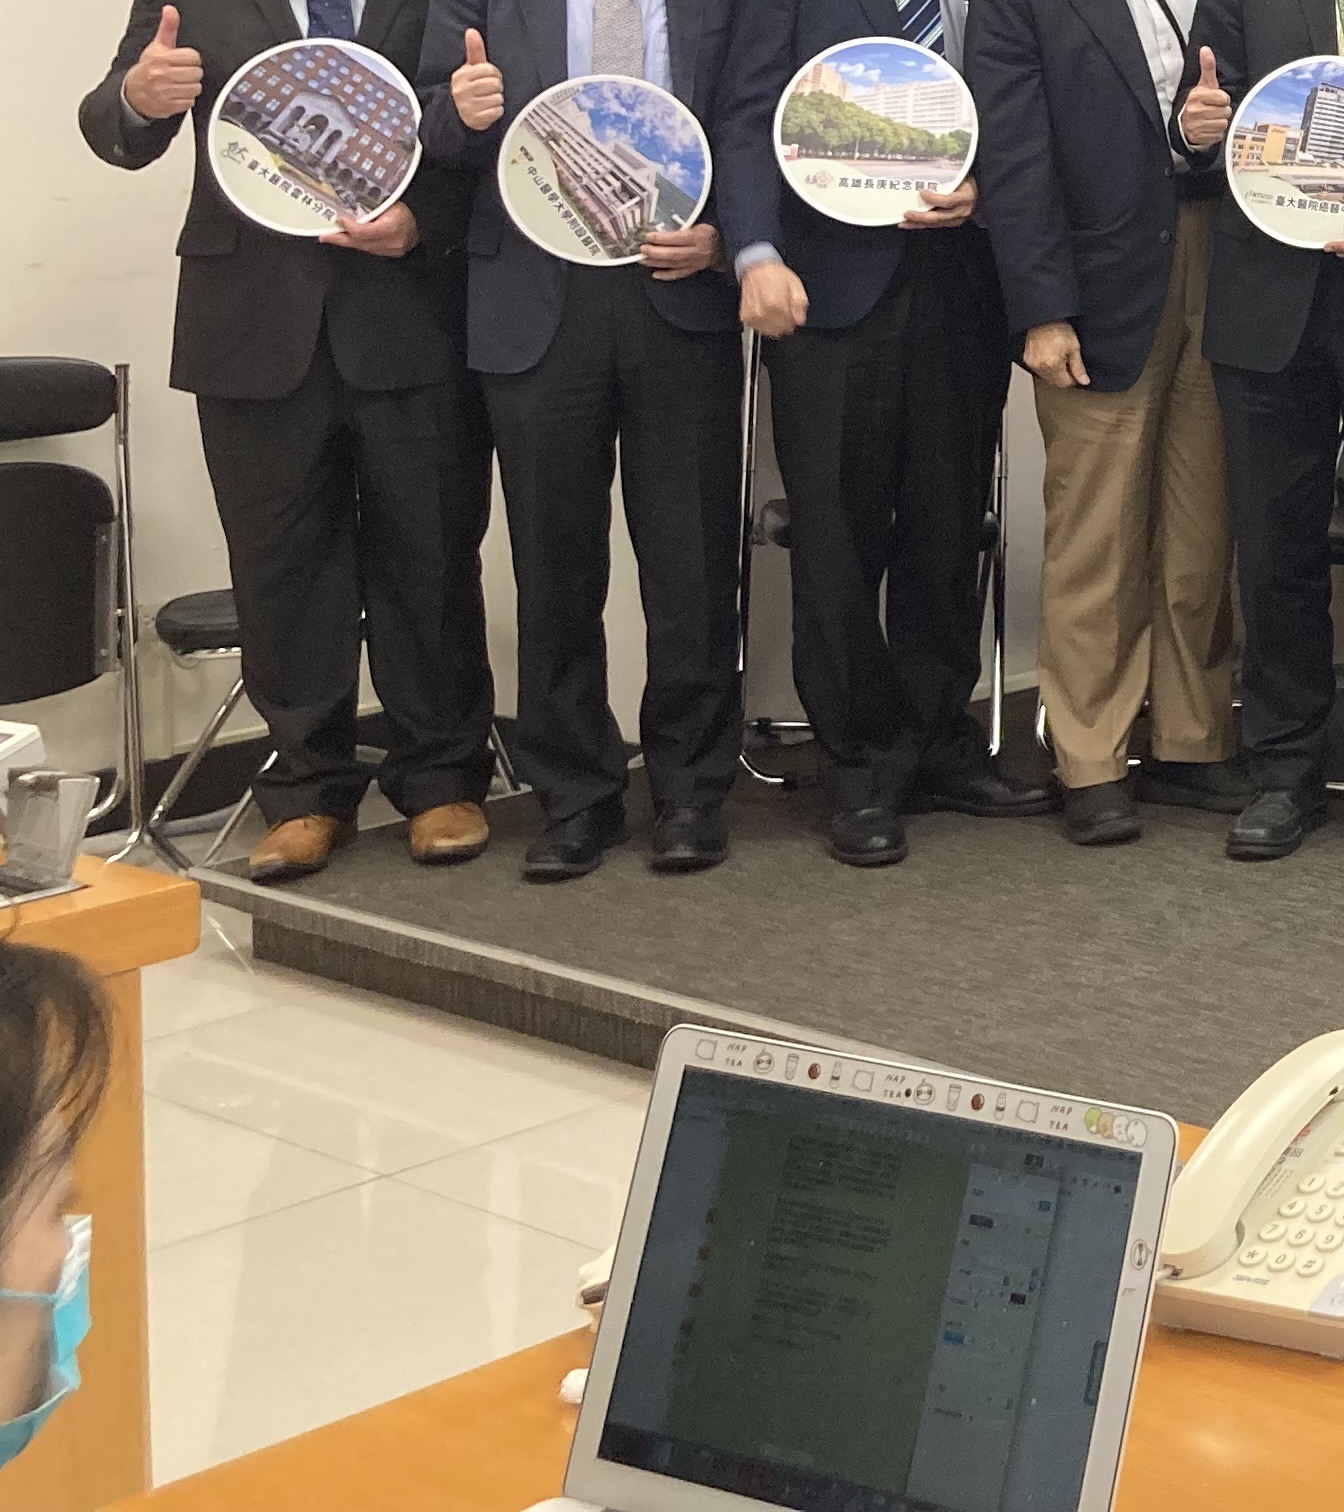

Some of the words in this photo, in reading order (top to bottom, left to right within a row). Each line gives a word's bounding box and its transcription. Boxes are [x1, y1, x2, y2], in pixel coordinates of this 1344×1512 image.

[247, 159, 335, 222] 臺大醫院雲林分院
[838, 177, 939, 192] 高雄長庚紀念醫院
[526, 166, 602, 257] 中山醫學大學附設醫院
[1051, 1105, 1073, 1116] NAP
